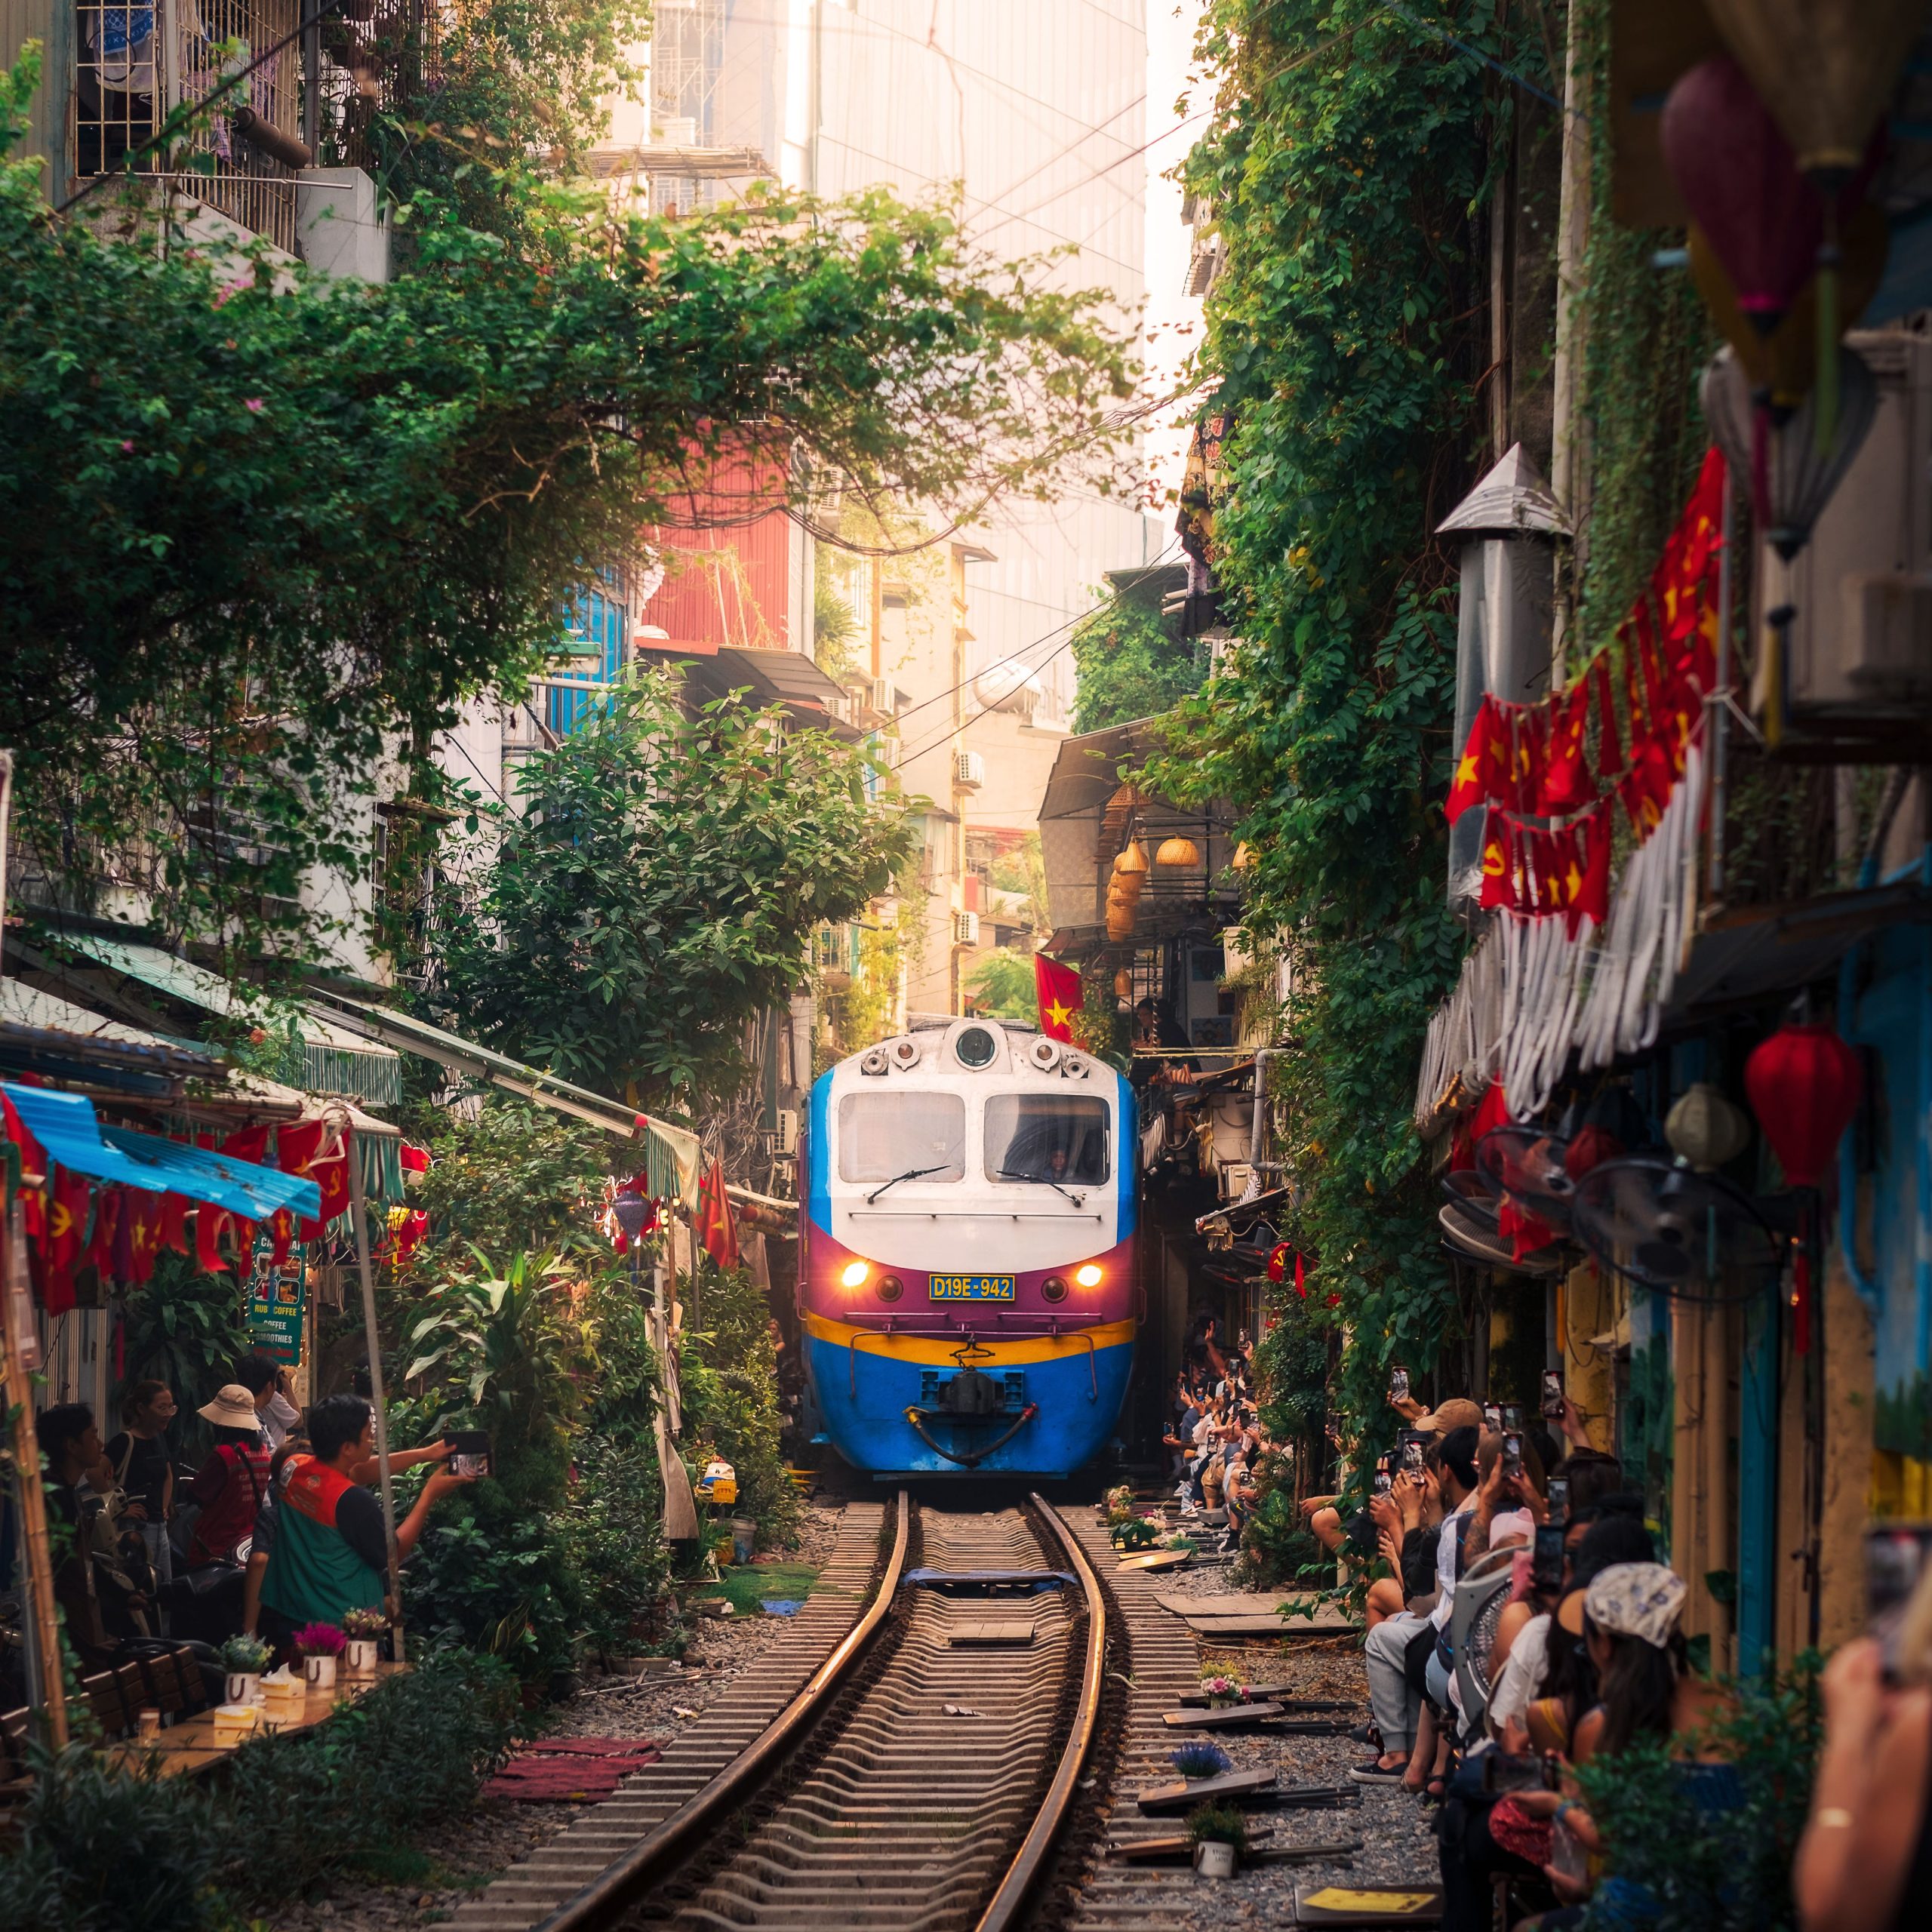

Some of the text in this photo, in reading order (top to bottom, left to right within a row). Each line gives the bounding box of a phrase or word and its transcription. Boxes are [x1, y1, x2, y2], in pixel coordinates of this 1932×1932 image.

[934, 1278, 1010, 1297] D19E-942
[254, 1304, 297, 1316] RUB COFFEE
[256, 1333, 293, 1344] SMOOTHIES
